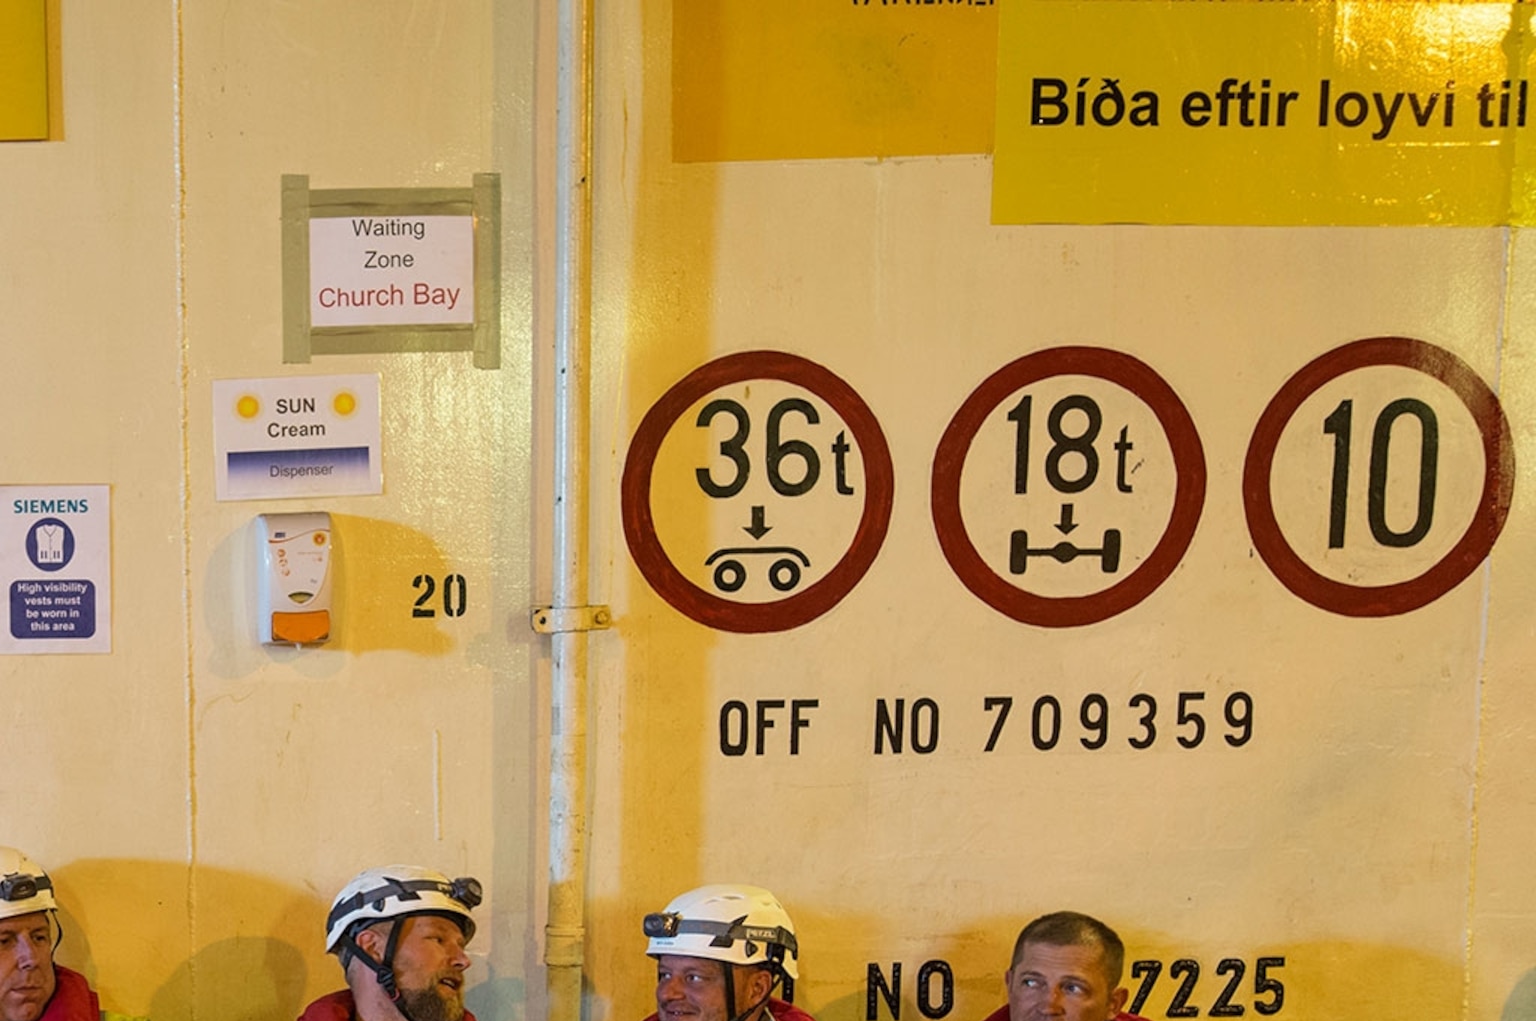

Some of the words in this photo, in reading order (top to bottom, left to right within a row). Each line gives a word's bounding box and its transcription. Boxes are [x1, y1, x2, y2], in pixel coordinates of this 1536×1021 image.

[1030, 77, 1160, 128] Bíða
[1181, 78, 1299, 128] eftir
[1476, 78, 1528, 129] til
[352, 219, 425, 240] Waiting
[364, 251, 415, 269] Zone
[319, 284, 405, 308] Church
[413, 283, 461, 310] Bay
[276, 398, 316, 415] SUN
[267, 422, 326, 438] Cream
[269, 465, 334, 479] Dispenser
[1322, 396, 1439, 550] 10
[13, 499, 89, 514] SIEMENS
[17, 583, 42, 594] High
[44, 582, 88, 594] visibility
[412, 573, 467, 618] 20
[24, 596, 52, 606] vests
[54, 596, 81, 606] must
[26, 609, 40, 619] be
[41, 610, 67, 619] worn
[69, 609, 80, 618] in
[31, 622, 51, 632] this
[52, 623, 75, 632] area
[719, 700, 819, 756] OFF
[874, 698, 940, 755] NO
[983, 691, 1254, 752] 709359
[865, 960, 955, 1021] NO
[1128, 957, 1287, 1019] 7225
